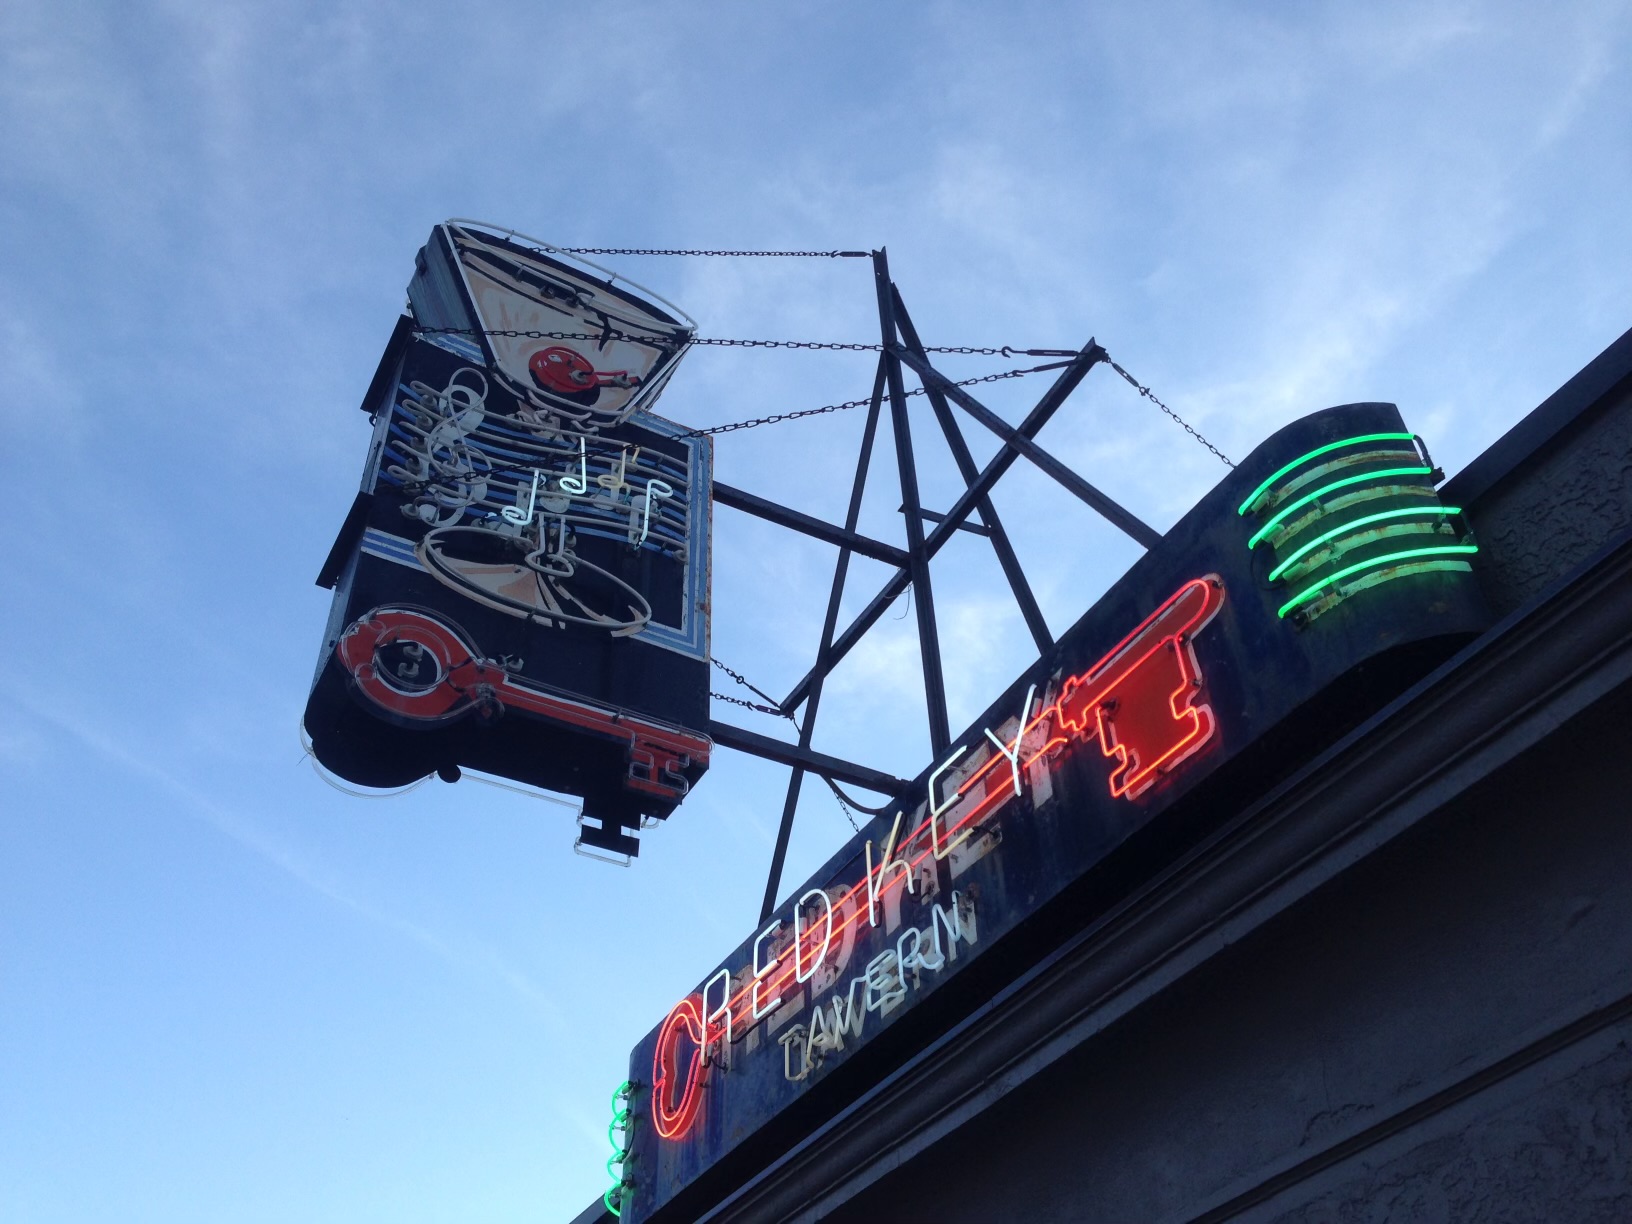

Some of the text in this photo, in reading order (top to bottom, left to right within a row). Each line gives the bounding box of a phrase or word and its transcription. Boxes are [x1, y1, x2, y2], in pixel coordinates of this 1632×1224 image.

[700, 682, 1050, 1069] RED KEY
[778, 889, 979, 1082] TAVERN
